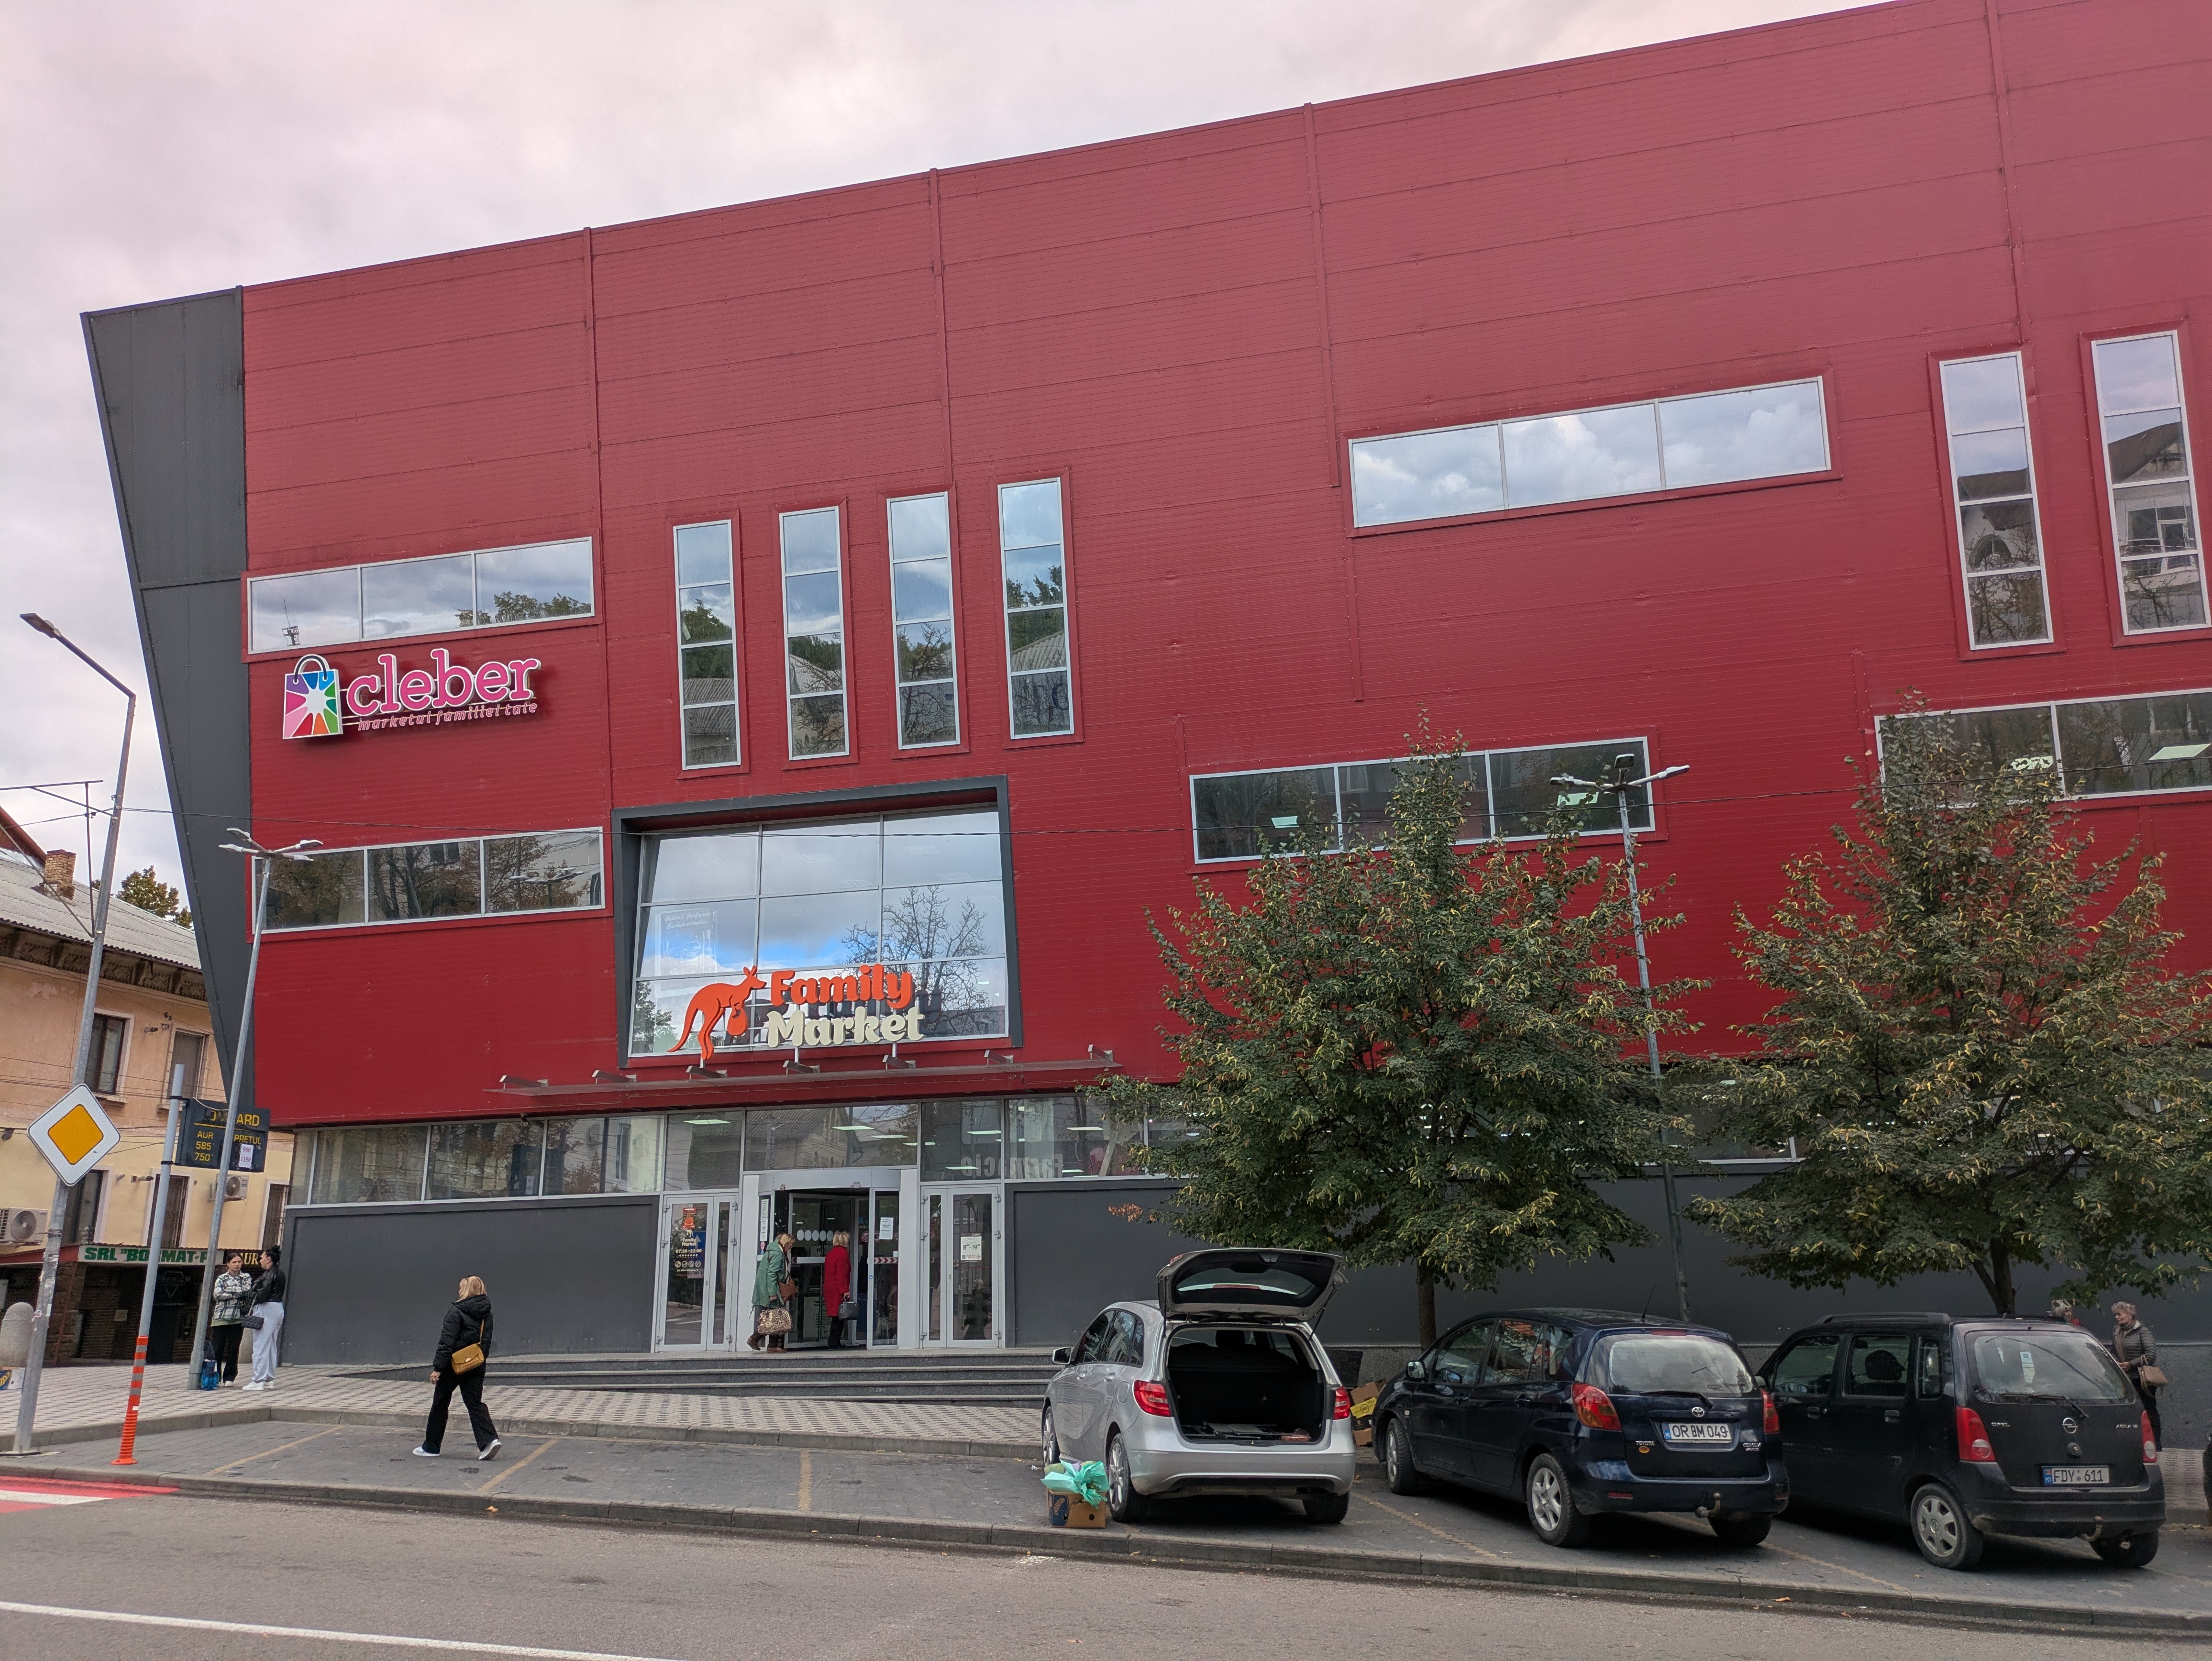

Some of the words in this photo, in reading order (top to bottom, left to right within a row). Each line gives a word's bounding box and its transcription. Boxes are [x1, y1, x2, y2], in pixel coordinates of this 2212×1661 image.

[346, 648, 542, 717] cleber
[358, 710, 431, 731] marketul
[436, 703, 500, 725] familiei
[505, 702, 538, 716] tale
[771, 963, 913, 1009] Family
[766, 1006, 925, 1048] Market
[197, 1130, 213, 1140] AUR
[84, 1247, 118, 1261] SRL
[1672, 1425, 1690, 1438] OR
[1690, 1425, 1705, 1438] BM
[1706, 1425, 1728, 1438] 049
[2053, 1470, 2075, 1482] FDY
[2084, 1469, 2103, 1482] 611
